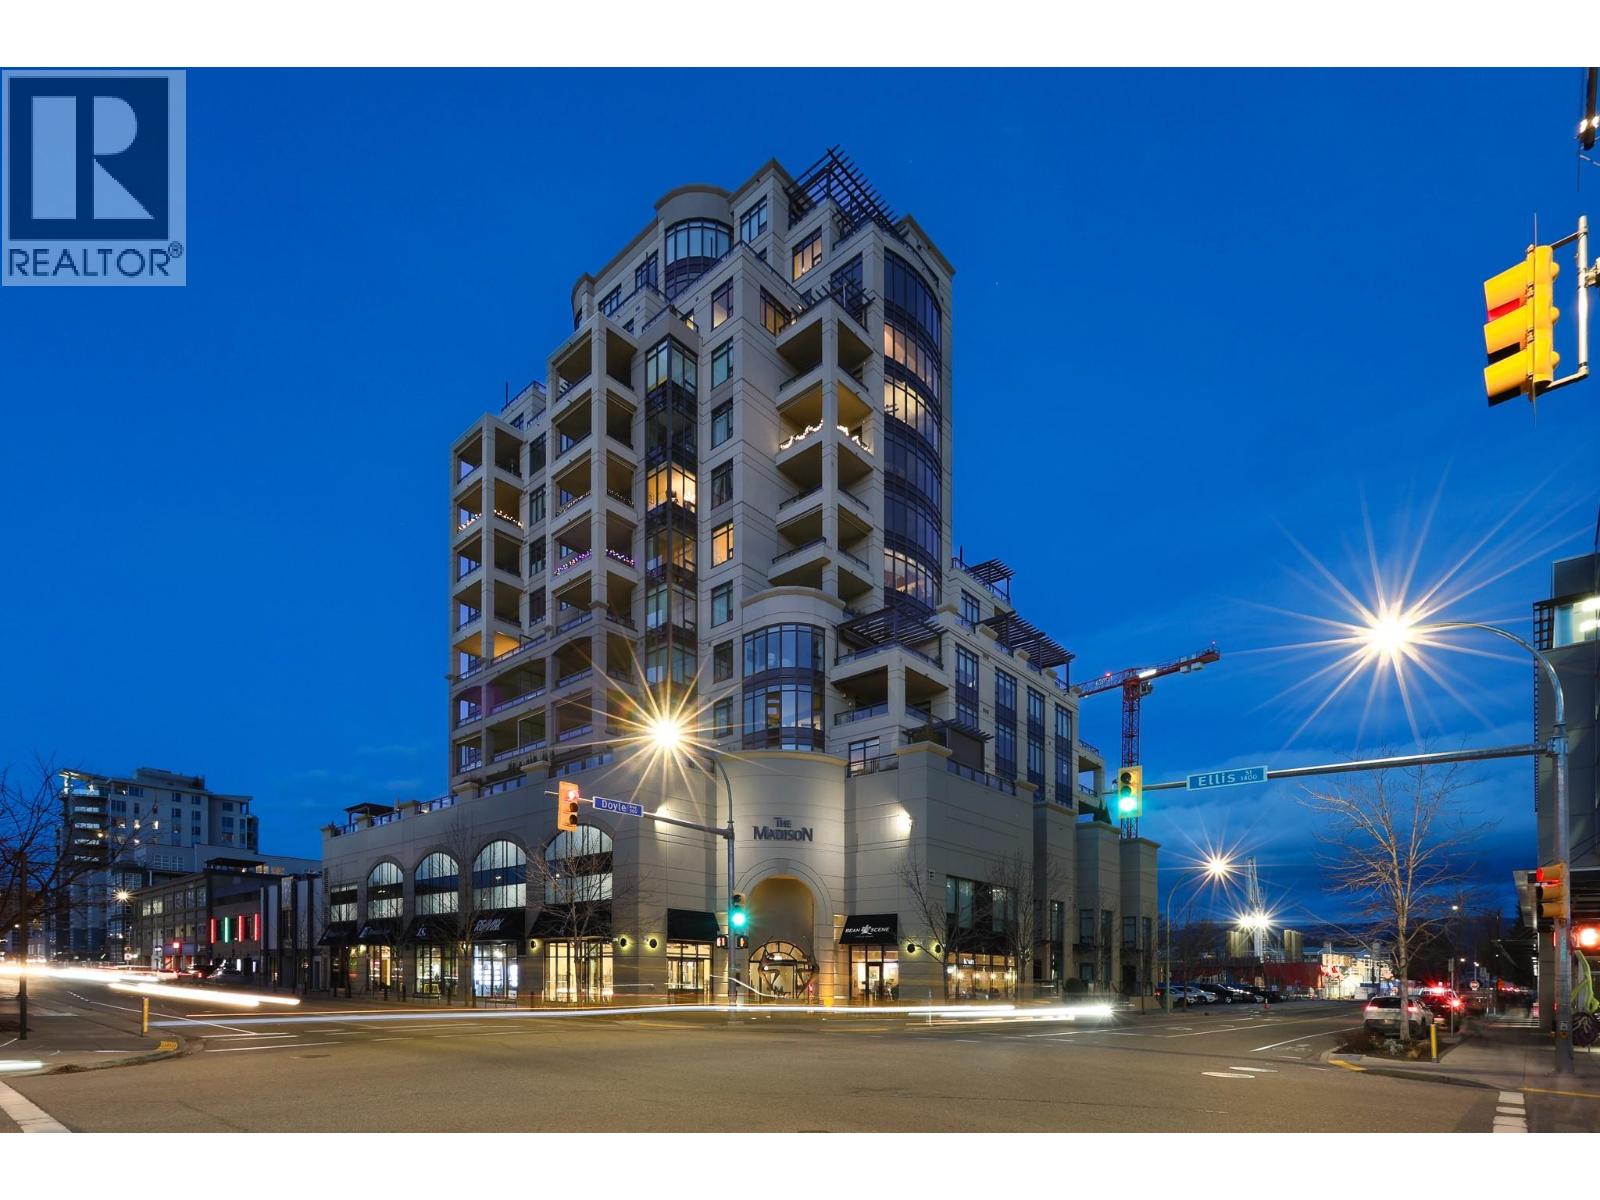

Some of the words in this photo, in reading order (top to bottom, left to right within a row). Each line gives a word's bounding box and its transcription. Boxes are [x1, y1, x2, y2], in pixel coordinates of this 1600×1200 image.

[1198, 772, 1236, 787] Ellis
[601, 799, 627, 812] Doyle
[774, 817, 792, 828] THE
[752, 826, 813, 842] MADISON
